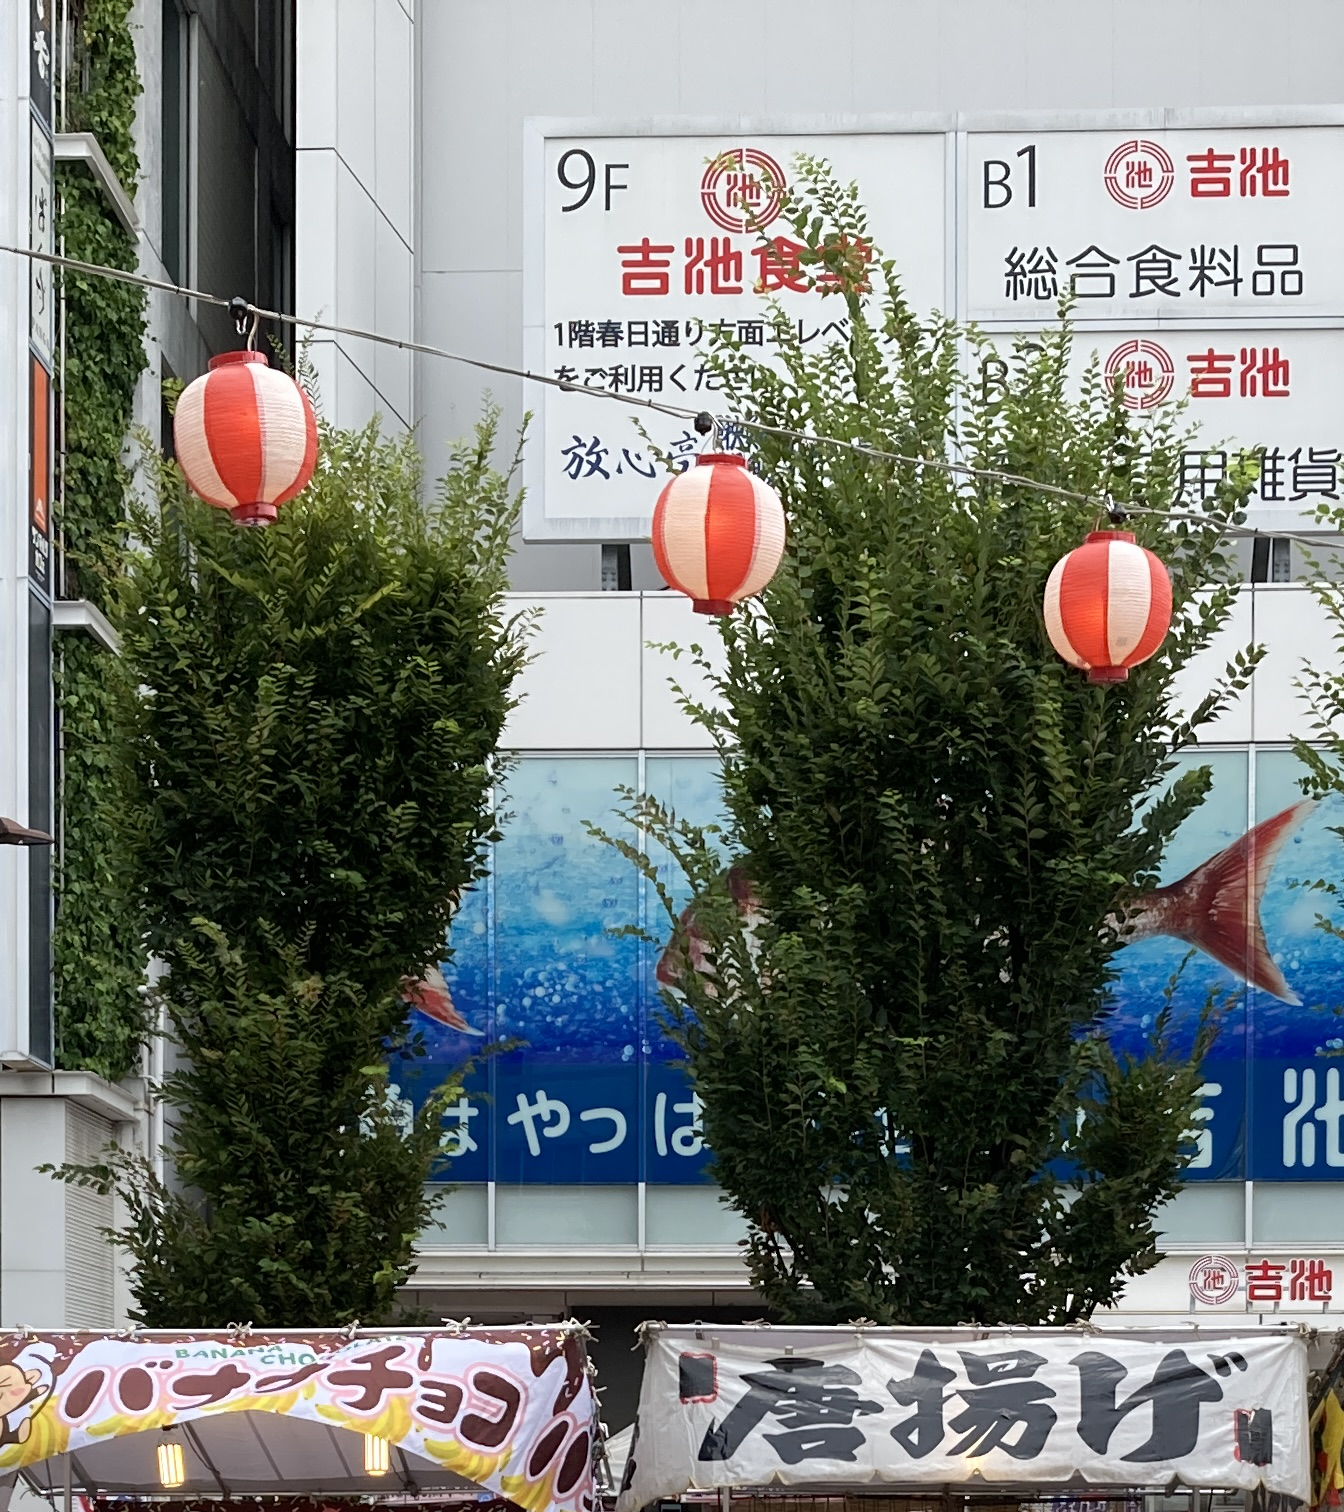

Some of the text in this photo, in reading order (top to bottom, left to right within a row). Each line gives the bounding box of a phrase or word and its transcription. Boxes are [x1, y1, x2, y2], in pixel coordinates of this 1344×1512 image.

[557, 149, 630, 212] 9F
[983, 145, 1037, 209] B1
[1186, 147, 1290, 198] 吉池
[1004, 244, 1304, 301] 総合食料品
[554, 364, 757, 393] をご利用くだ
[1186, 347, 1290, 398] 吉池
[1245, 1259, 1333, 1301] 吉池
[175, 1343, 284, 1359] BANANA
[60, 1346, 528, 1452] バナナチョコ
[698, 1348, 1249, 1464] 唐揚げ
